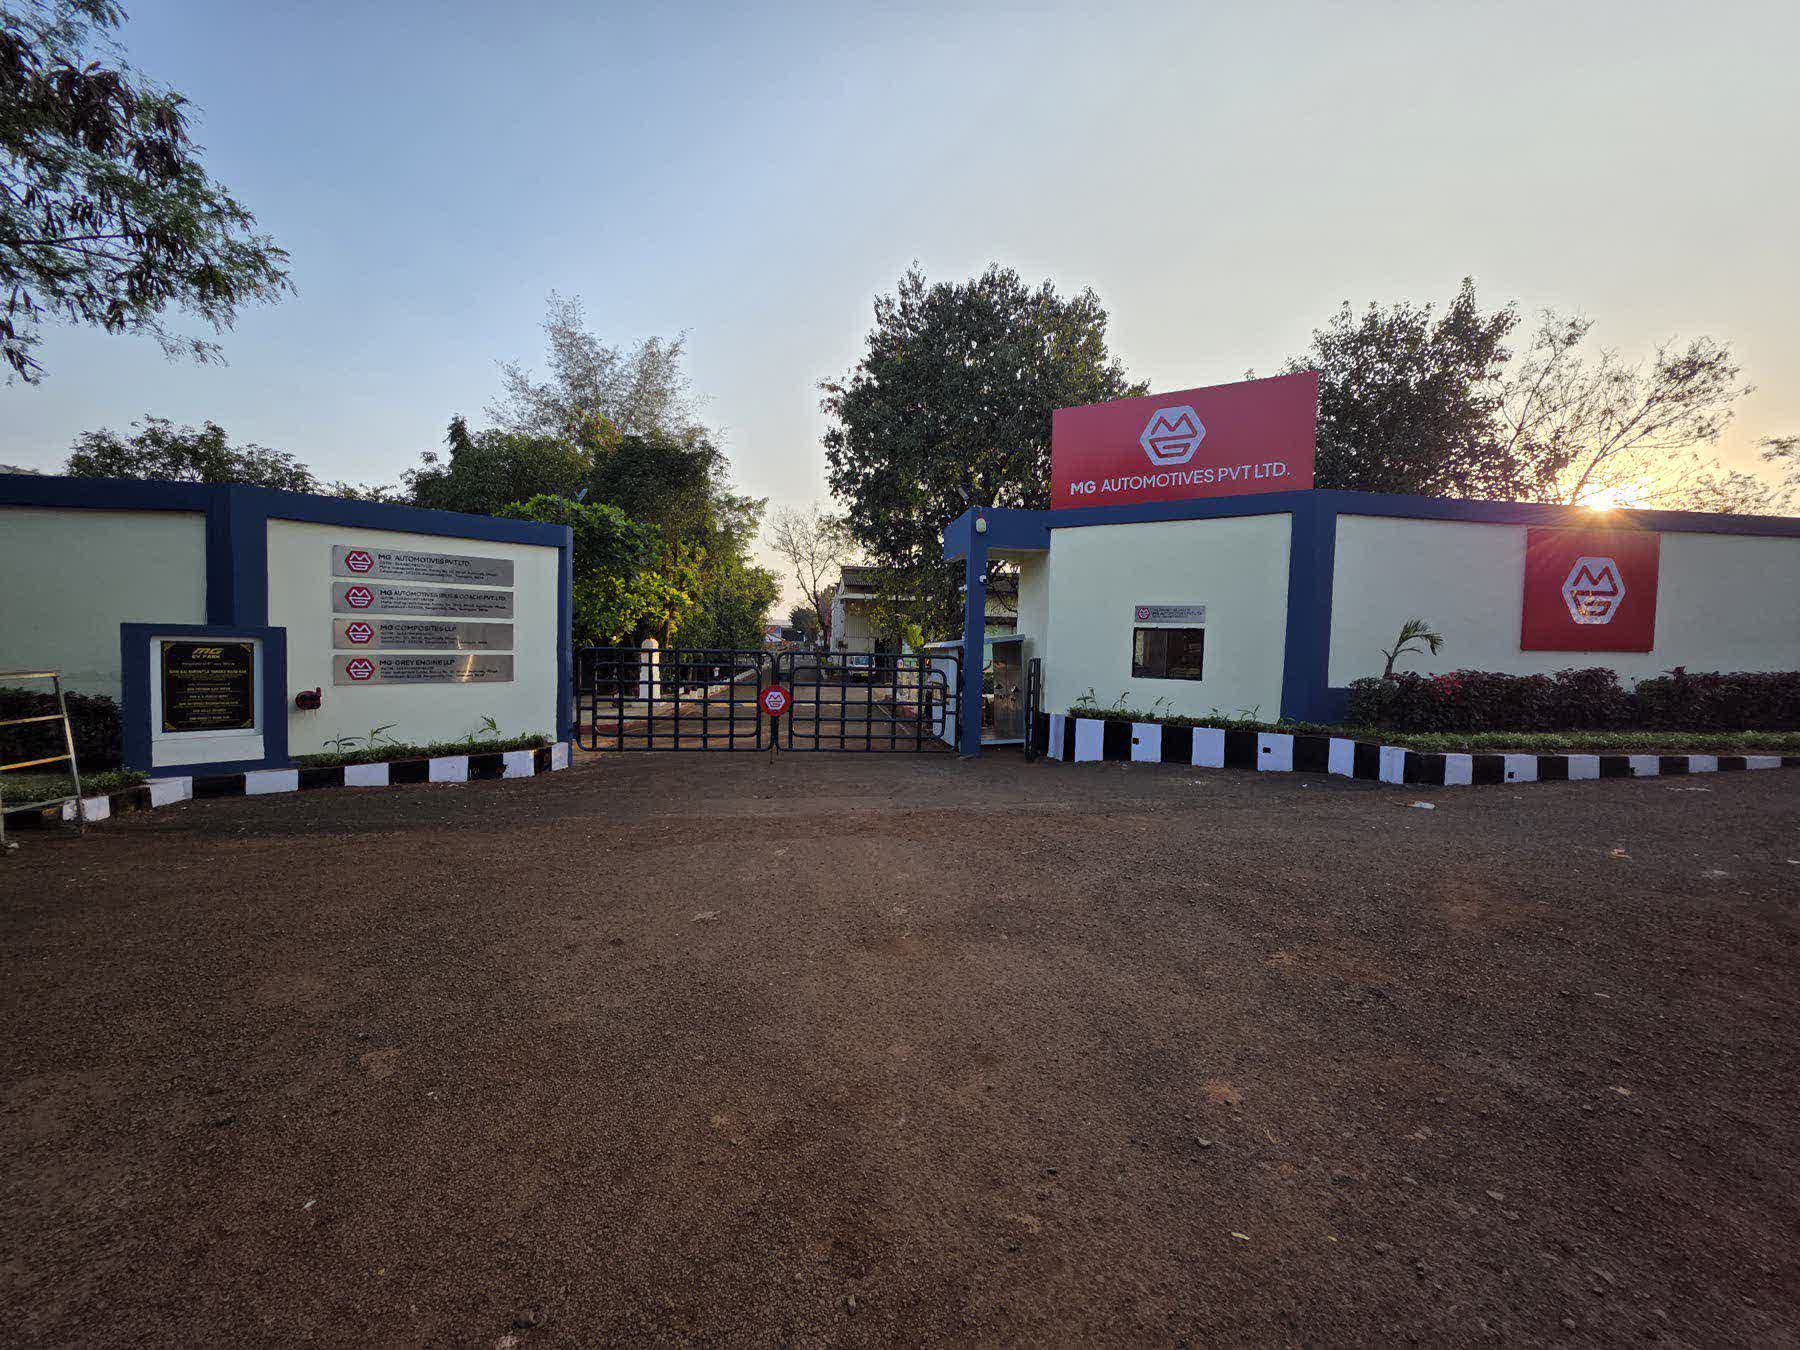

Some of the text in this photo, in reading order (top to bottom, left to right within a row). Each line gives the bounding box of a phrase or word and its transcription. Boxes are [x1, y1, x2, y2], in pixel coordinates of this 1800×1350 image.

[1070, 461, 1291, 497] MG AUTOMOTIVES PVT LTD.
[378, 553, 392, 561] MG
[395, 555, 444, 565] AUTOMOTIVES
[444, 559, 457, 567] PVT
[380, 589, 393, 597] MG
[394, 590, 438, 599] AUTOMOTIVES
[395, 624, 444, 632] COMPOSITES
[395, 659, 415, 667] GREY
[416, 659, 442, 667] ENGINE
